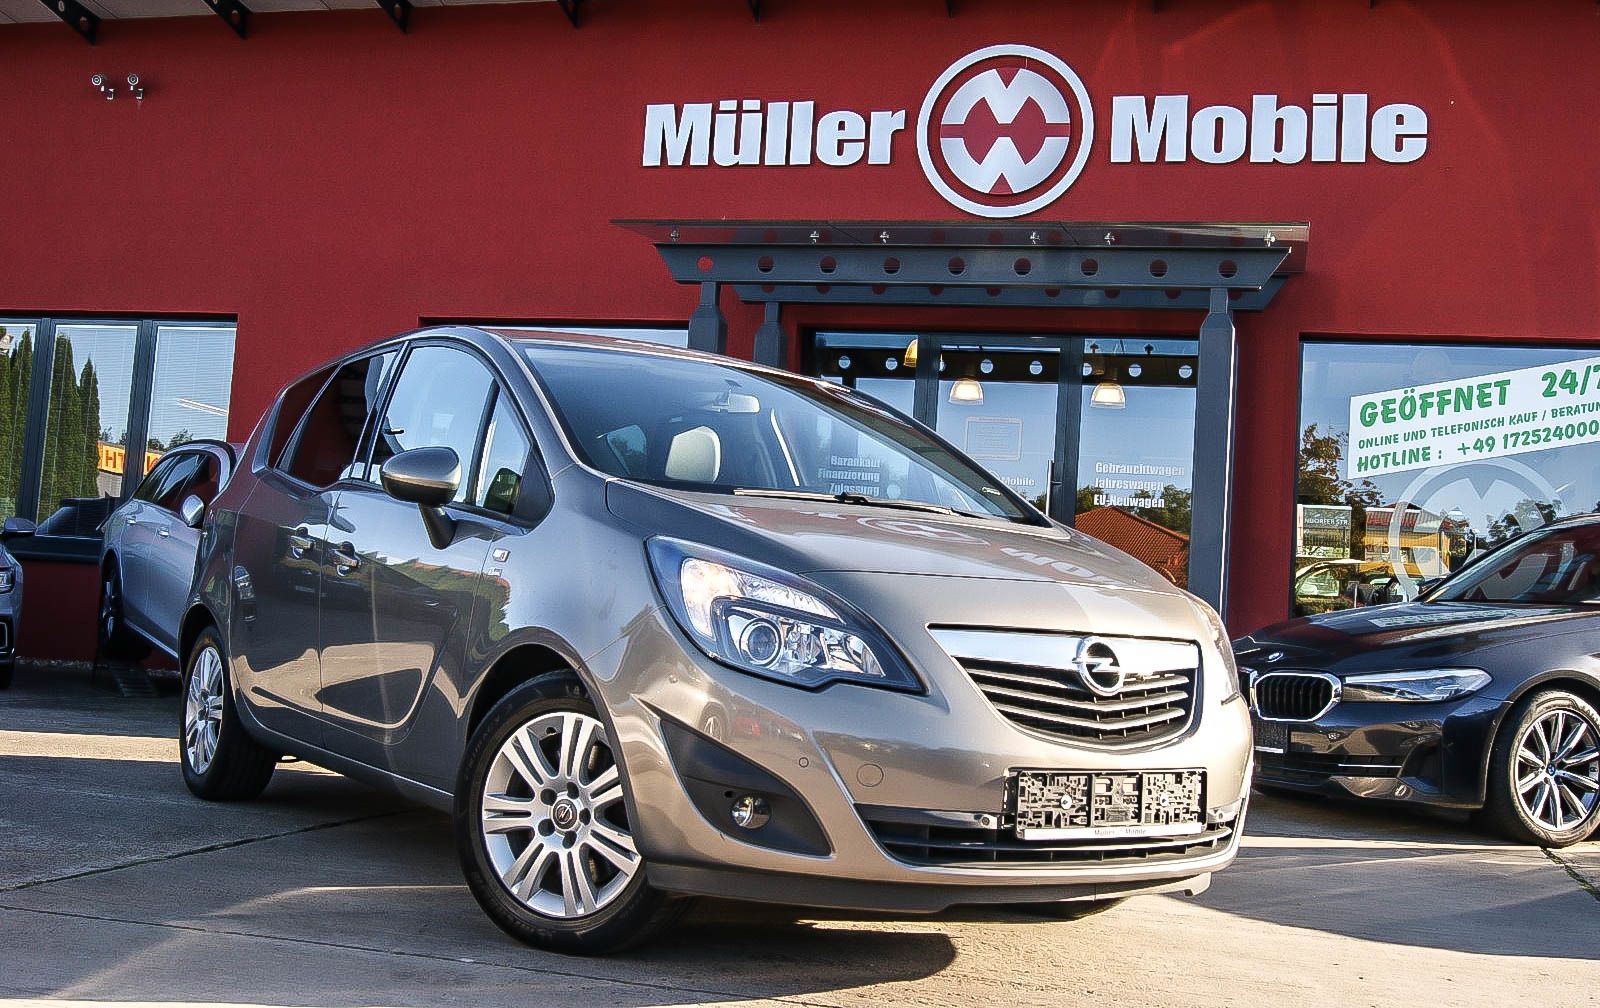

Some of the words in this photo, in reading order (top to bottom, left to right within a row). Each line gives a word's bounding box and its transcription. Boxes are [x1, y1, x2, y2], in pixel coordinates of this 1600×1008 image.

[642, 98, 906, 168] Müller
[1110, 93, 1429, 165] Mobile
[1359, 379, 1511, 428] GEÖFFNET
[1358, 433, 1399, 450] ONLINE
[1403, 429, 1427, 442] UND
[1431, 416, 1505, 438] TELEFONISCH
[1509, 411, 1538, 426] KAUF
[1356, 446, 1431, 473] HOTLINE
[1457, 435, 1496, 456] +49
[1502, 419, 1600, 449] 172524000
[817, 467, 881, 483] Finanzierung
[1095, 462, 1185, 477] Gebrauchtwagen
[828, 482, 881, 497] Zulassung
[1094, 478, 1165, 492] Jahreswagen
[1093, 494, 1165, 509] EU-Neuwagen
